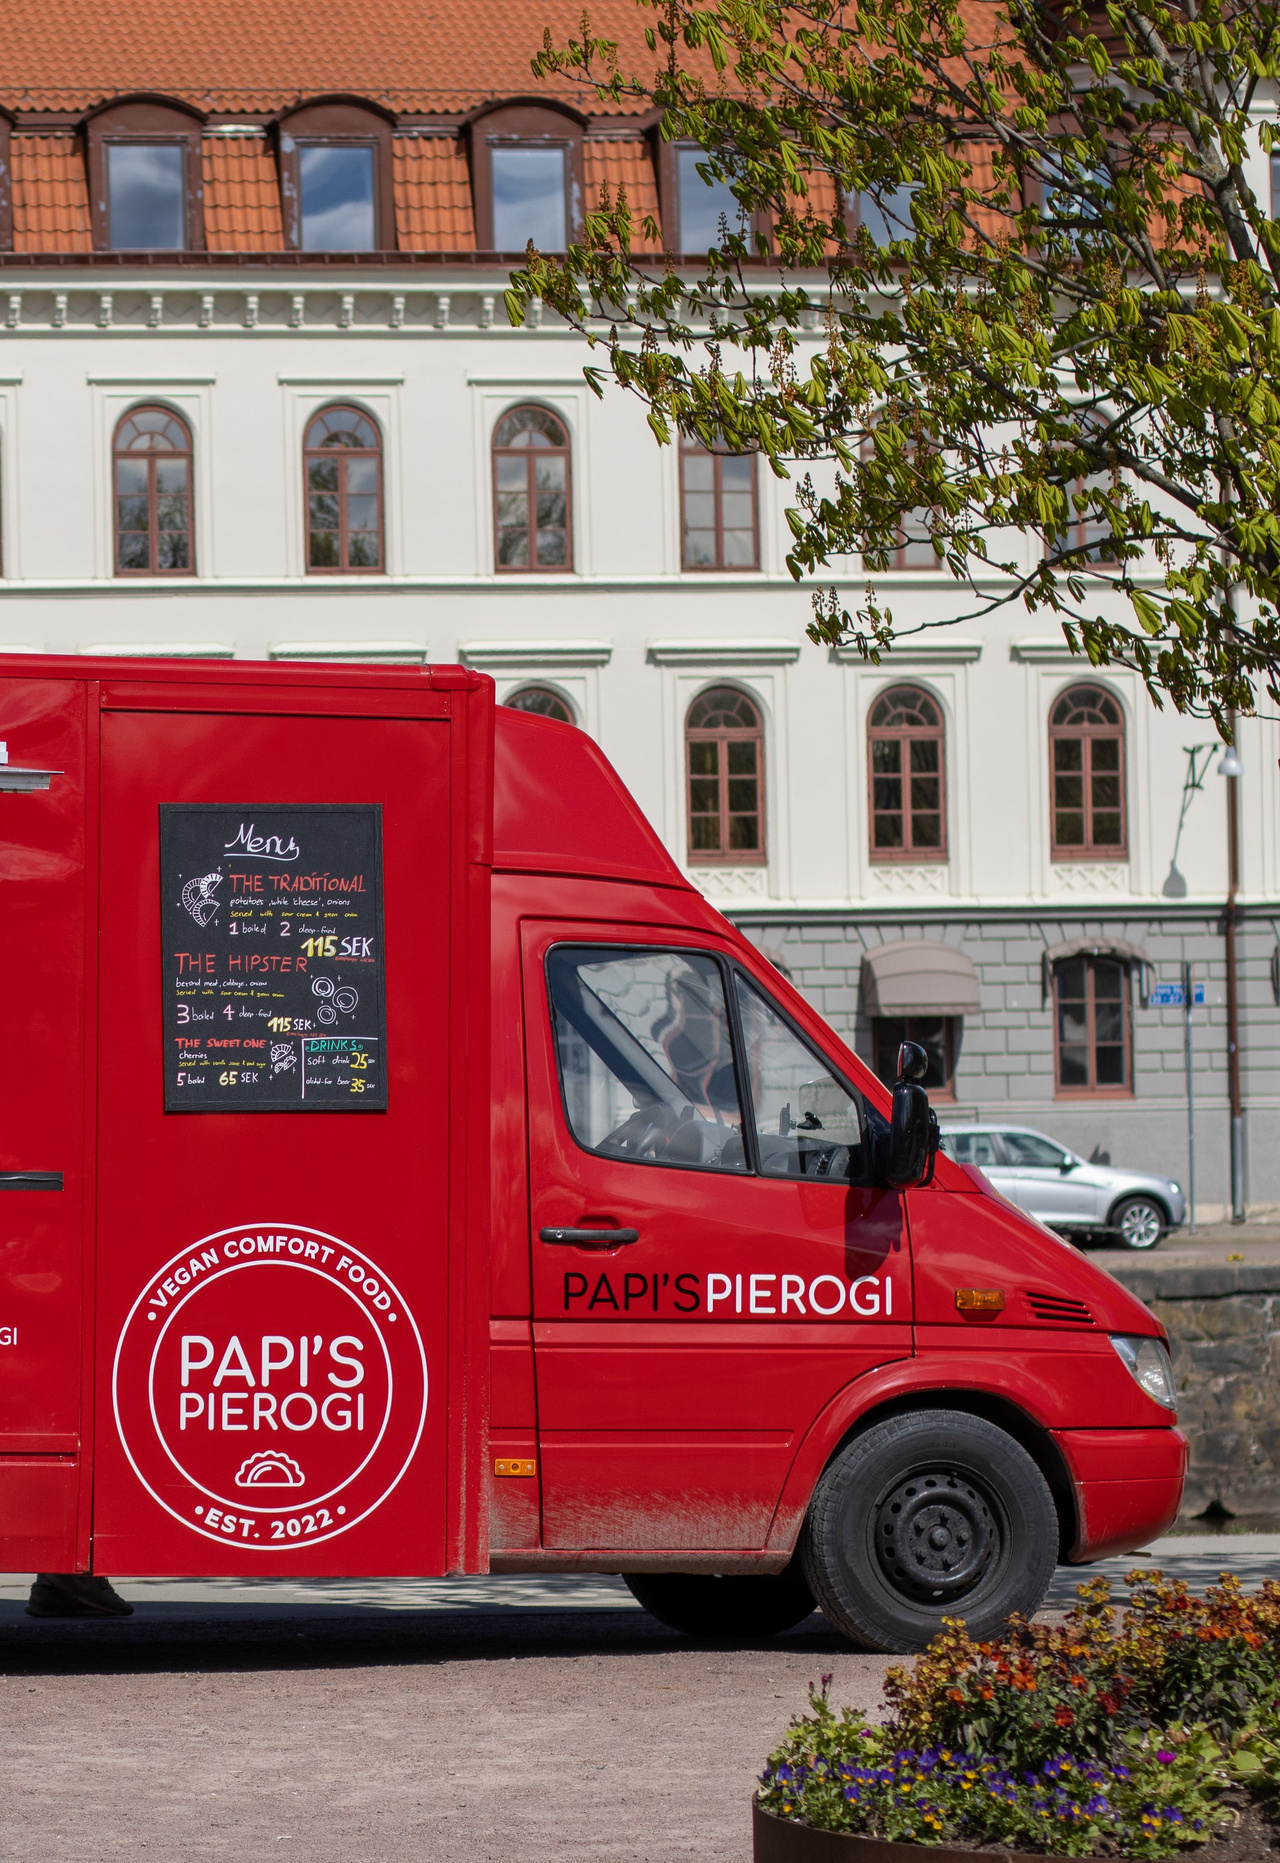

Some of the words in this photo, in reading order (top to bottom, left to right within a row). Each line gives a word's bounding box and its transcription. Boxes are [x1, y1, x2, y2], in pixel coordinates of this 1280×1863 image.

[225, 823, 300, 861] Menu
[230, 874, 265, 894] THE
[269, 871, 367, 893] TRADITIONAL
[230, 896, 264, 907] potatoes
[229, 921, 239, 935] 1
[242, 922, 267, 934] boiled
[280, 921, 291, 936] 2
[299, 924, 336, 935] deep-fried
[300, 935, 339, 958] 115
[339, 936, 374, 958] SEK
[174, 953, 216, 975] THE
[229, 954, 308, 974] HIPSTER
[175, 977, 201, 988] beyond
[177, 1004, 190, 1024] 3
[192, 1007, 215, 1021] boiled
[222, 1004, 235, 1021] 4
[239, 1005, 272, 1018] deep-fried
[267, 1017, 292, 1033] 115
[293, 1018, 312, 1031] SEK
[174, 1038, 201, 1049] THE
[206, 1038, 241, 1048] SWEET
[243, 1039, 267, 1048] ONE
[310, 1040, 357, 1052] DRINKS
[179, 1050, 208, 1060] cherries
[307, 1056, 325, 1066] soft
[332, 1056, 350, 1065] drink
[350, 1052, 369, 1069] 25
[177, 1072, 186, 1086] 5
[188, 1073, 205, 1085] boiled
[219, 1071, 238, 1086] 65
[241, 1072, 259, 1083] SEK
[337, 1076, 351, 1085] beer
[350, 1078, 366, 1092] 35
[149, 1248, 221, 1309] VEGAN
[223, 1235, 336, 1265] COMFORT
[335, 1255, 392, 1312] FOOD
[180, 1334, 366, 1389] PAPI'S
[179, 1391, 365, 1432] PIEROGI
[203, 1507, 261, 1540] EST.
[270, 1508, 335, 1540] 2022
